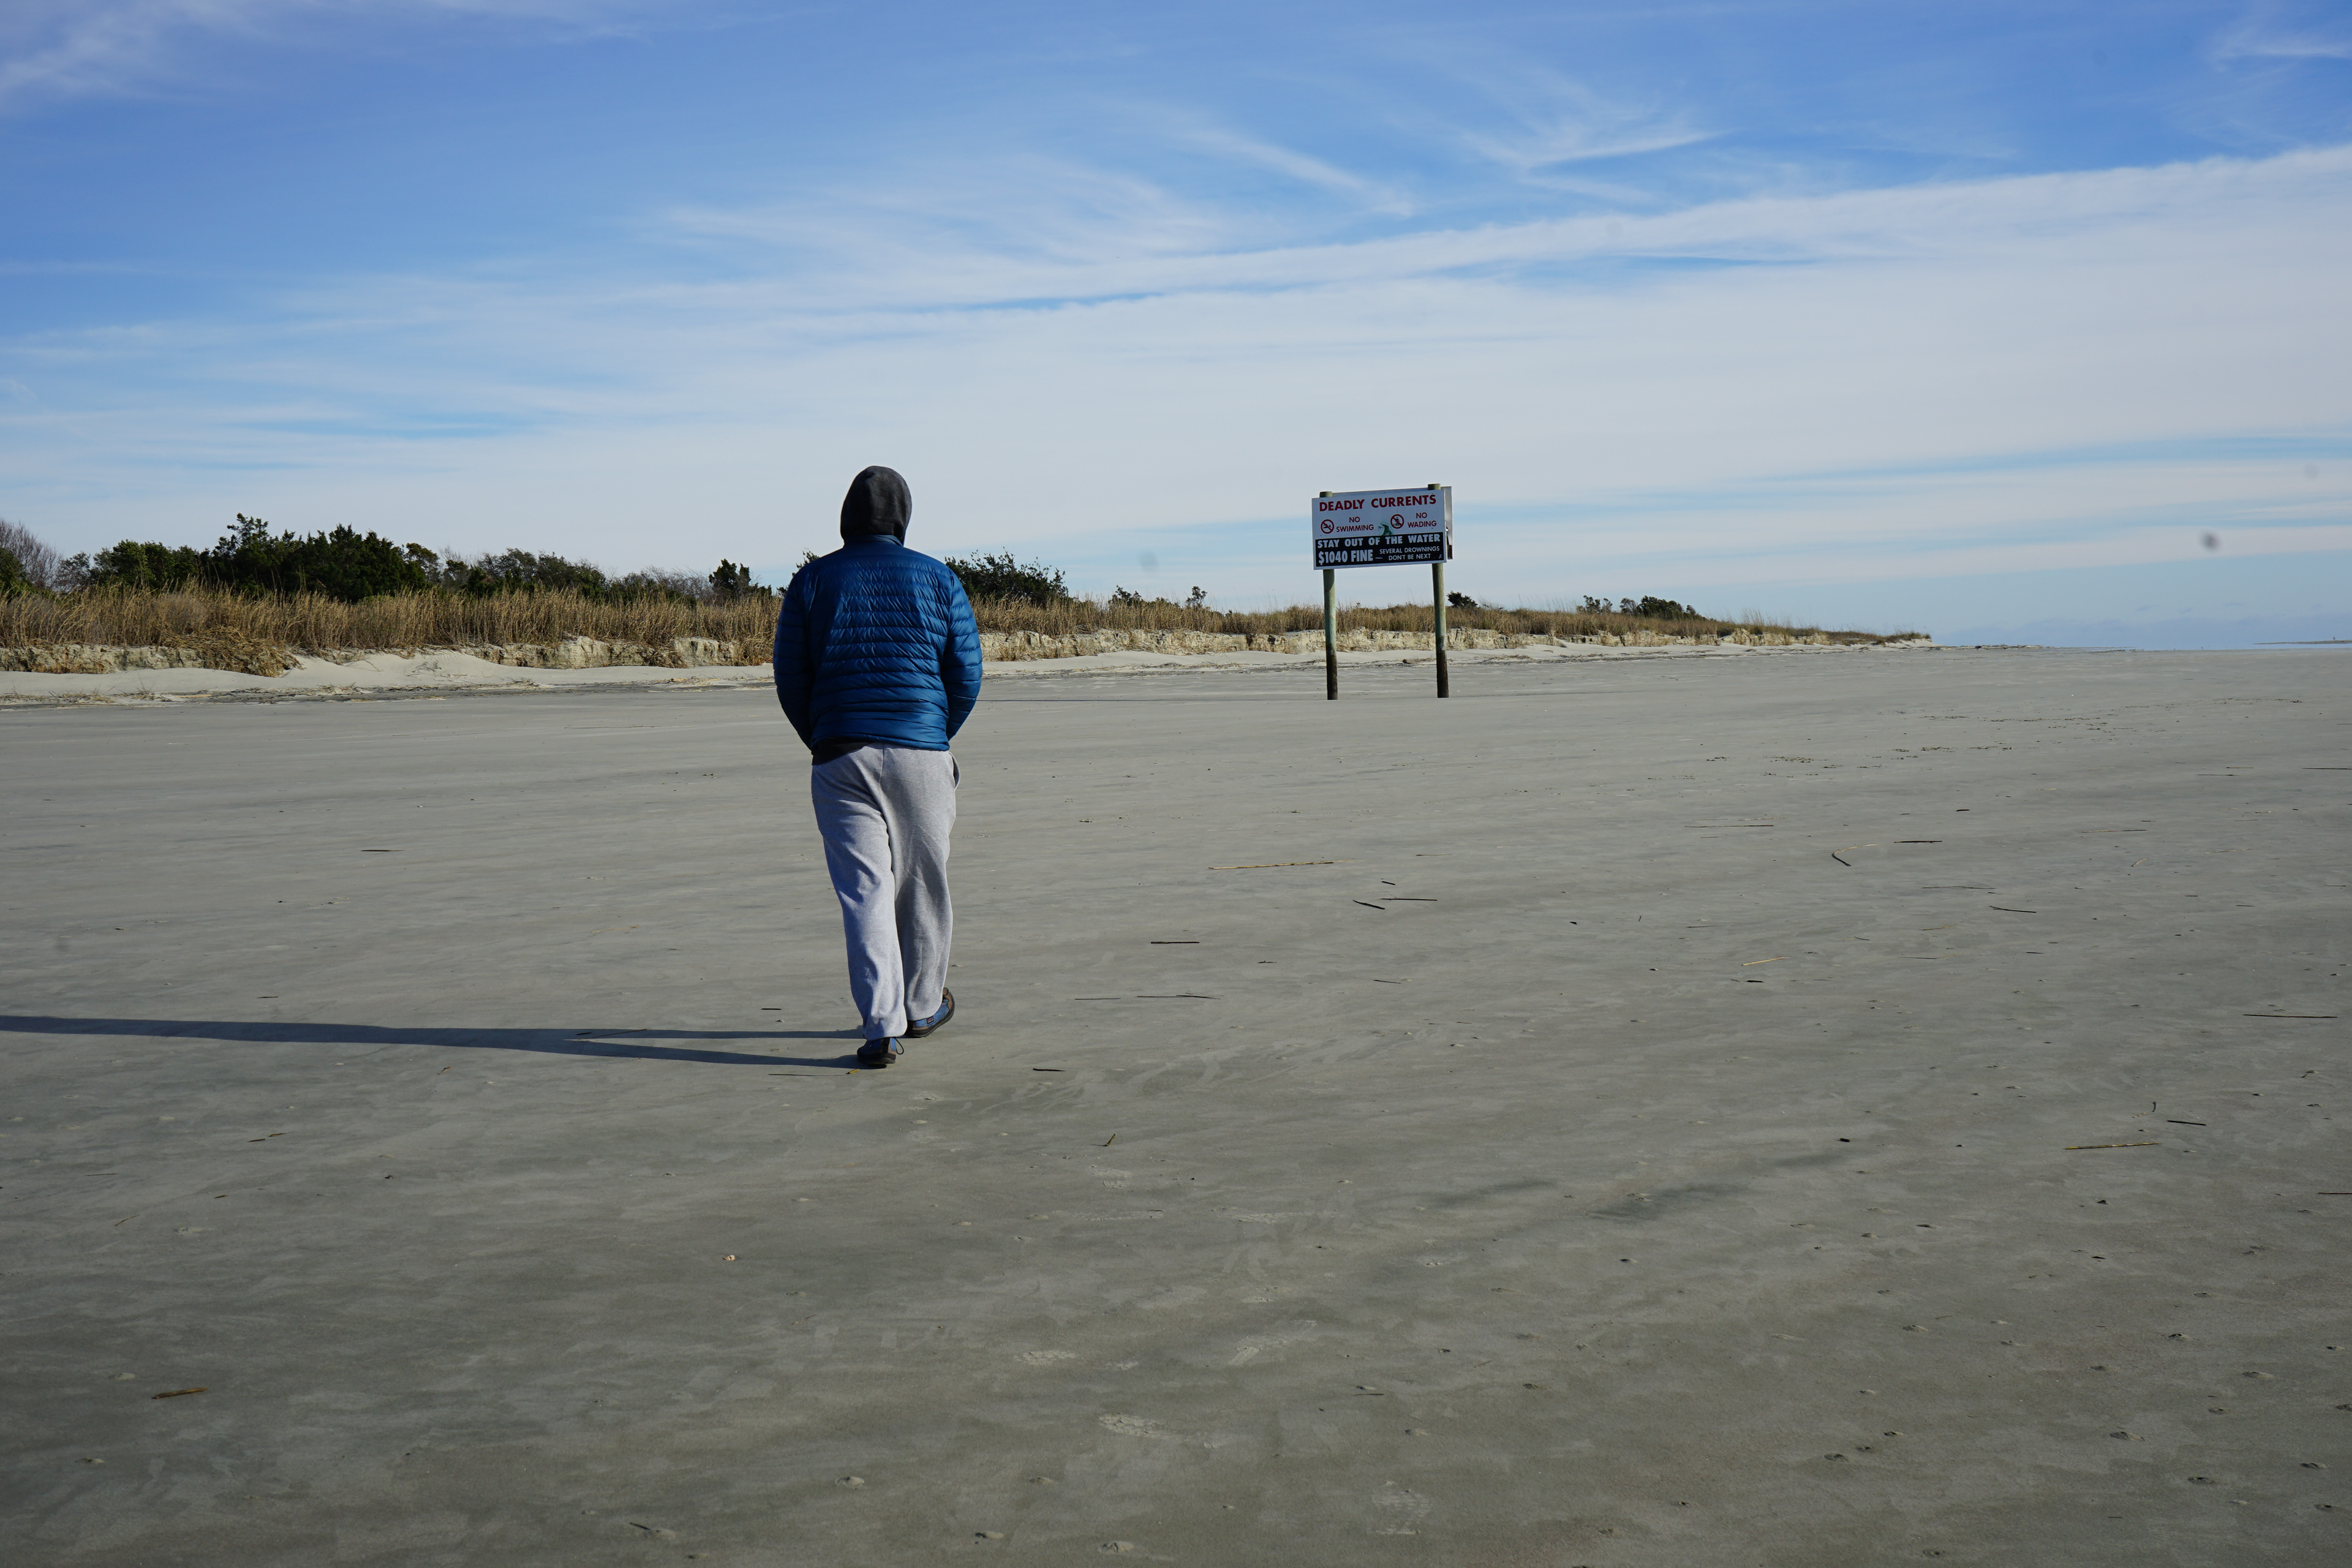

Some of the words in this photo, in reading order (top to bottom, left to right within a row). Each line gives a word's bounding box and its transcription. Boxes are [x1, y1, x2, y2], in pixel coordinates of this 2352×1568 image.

[1319, 499, 1365, 511] DEADLY
[1371, 494, 1436, 508] CURRENTS
[1317, 540, 1340, 548] STAY
[1344, 538, 1363, 546] OUT
[1368, 537, 1380, 546] OF
[1385, 536, 1403, 545] THE
[1408, 533, 1440, 543] WATER
[1318, 551, 1348, 566] $1040
[1351, 549, 1373, 562] FINE
